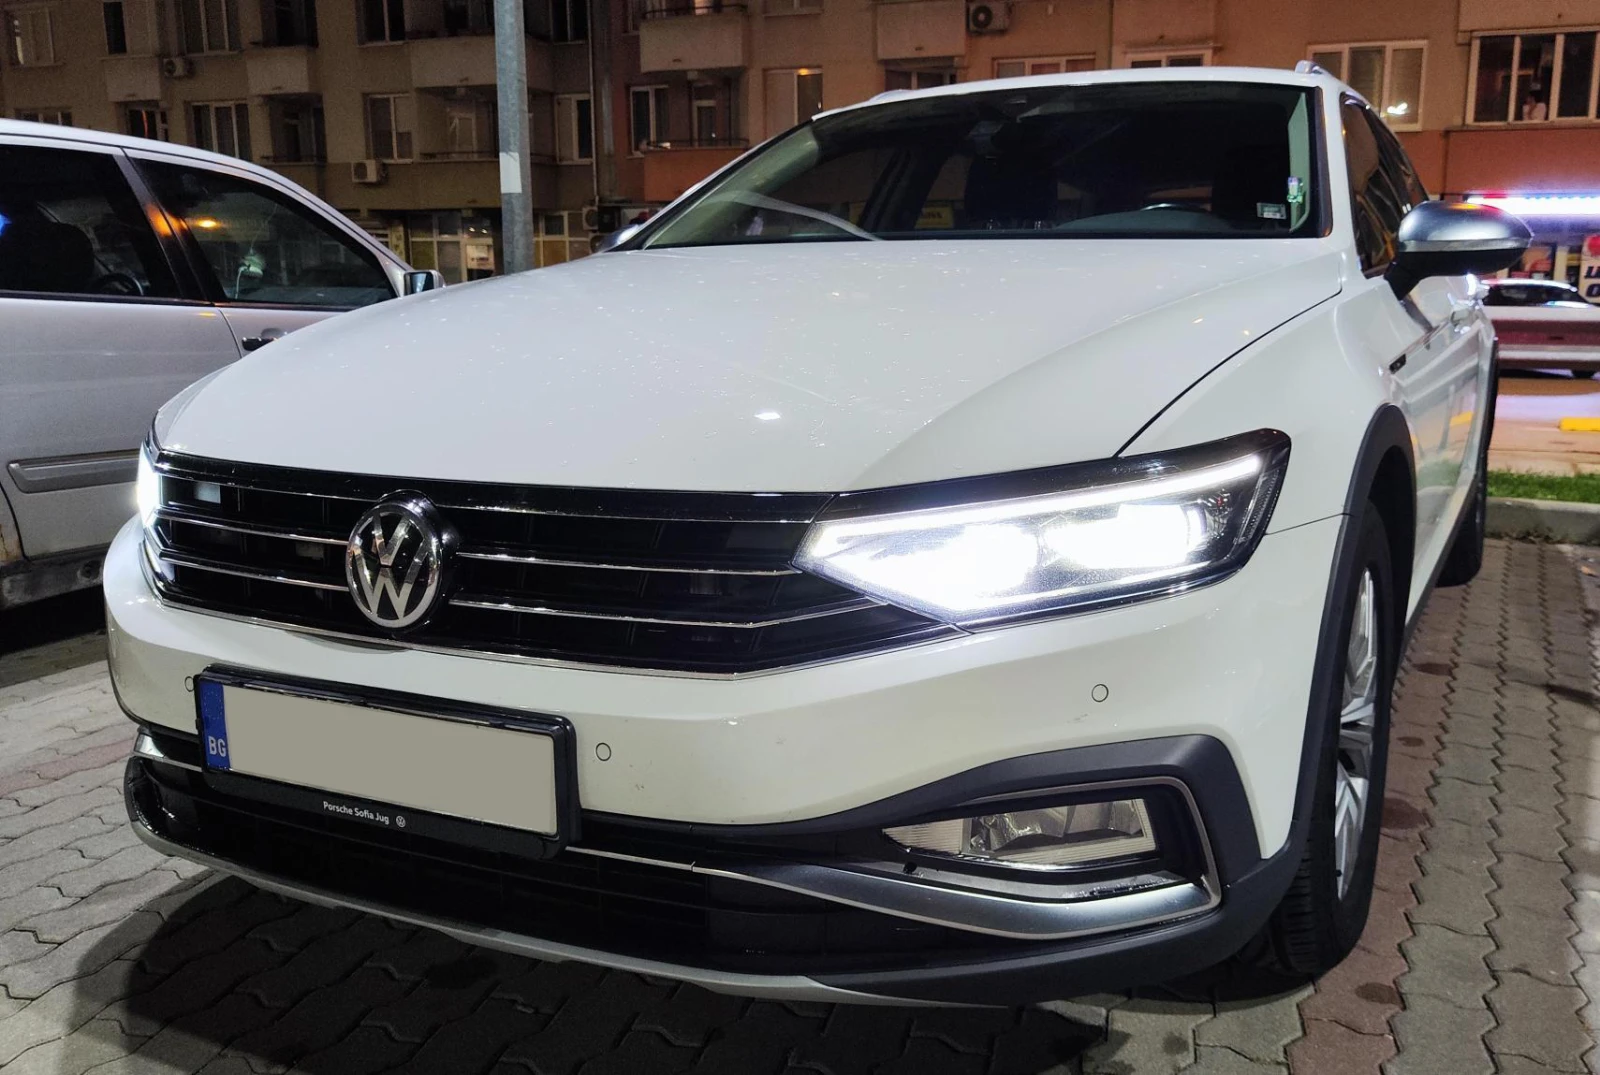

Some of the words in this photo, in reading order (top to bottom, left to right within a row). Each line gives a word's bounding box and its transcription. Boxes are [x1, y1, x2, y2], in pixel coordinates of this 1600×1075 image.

[208, 735, 227, 757] BG
[323, 801, 353, 815] Porsche
[354, 807, 375, 820] Sofia
[375, 812, 390, 825] Jug
